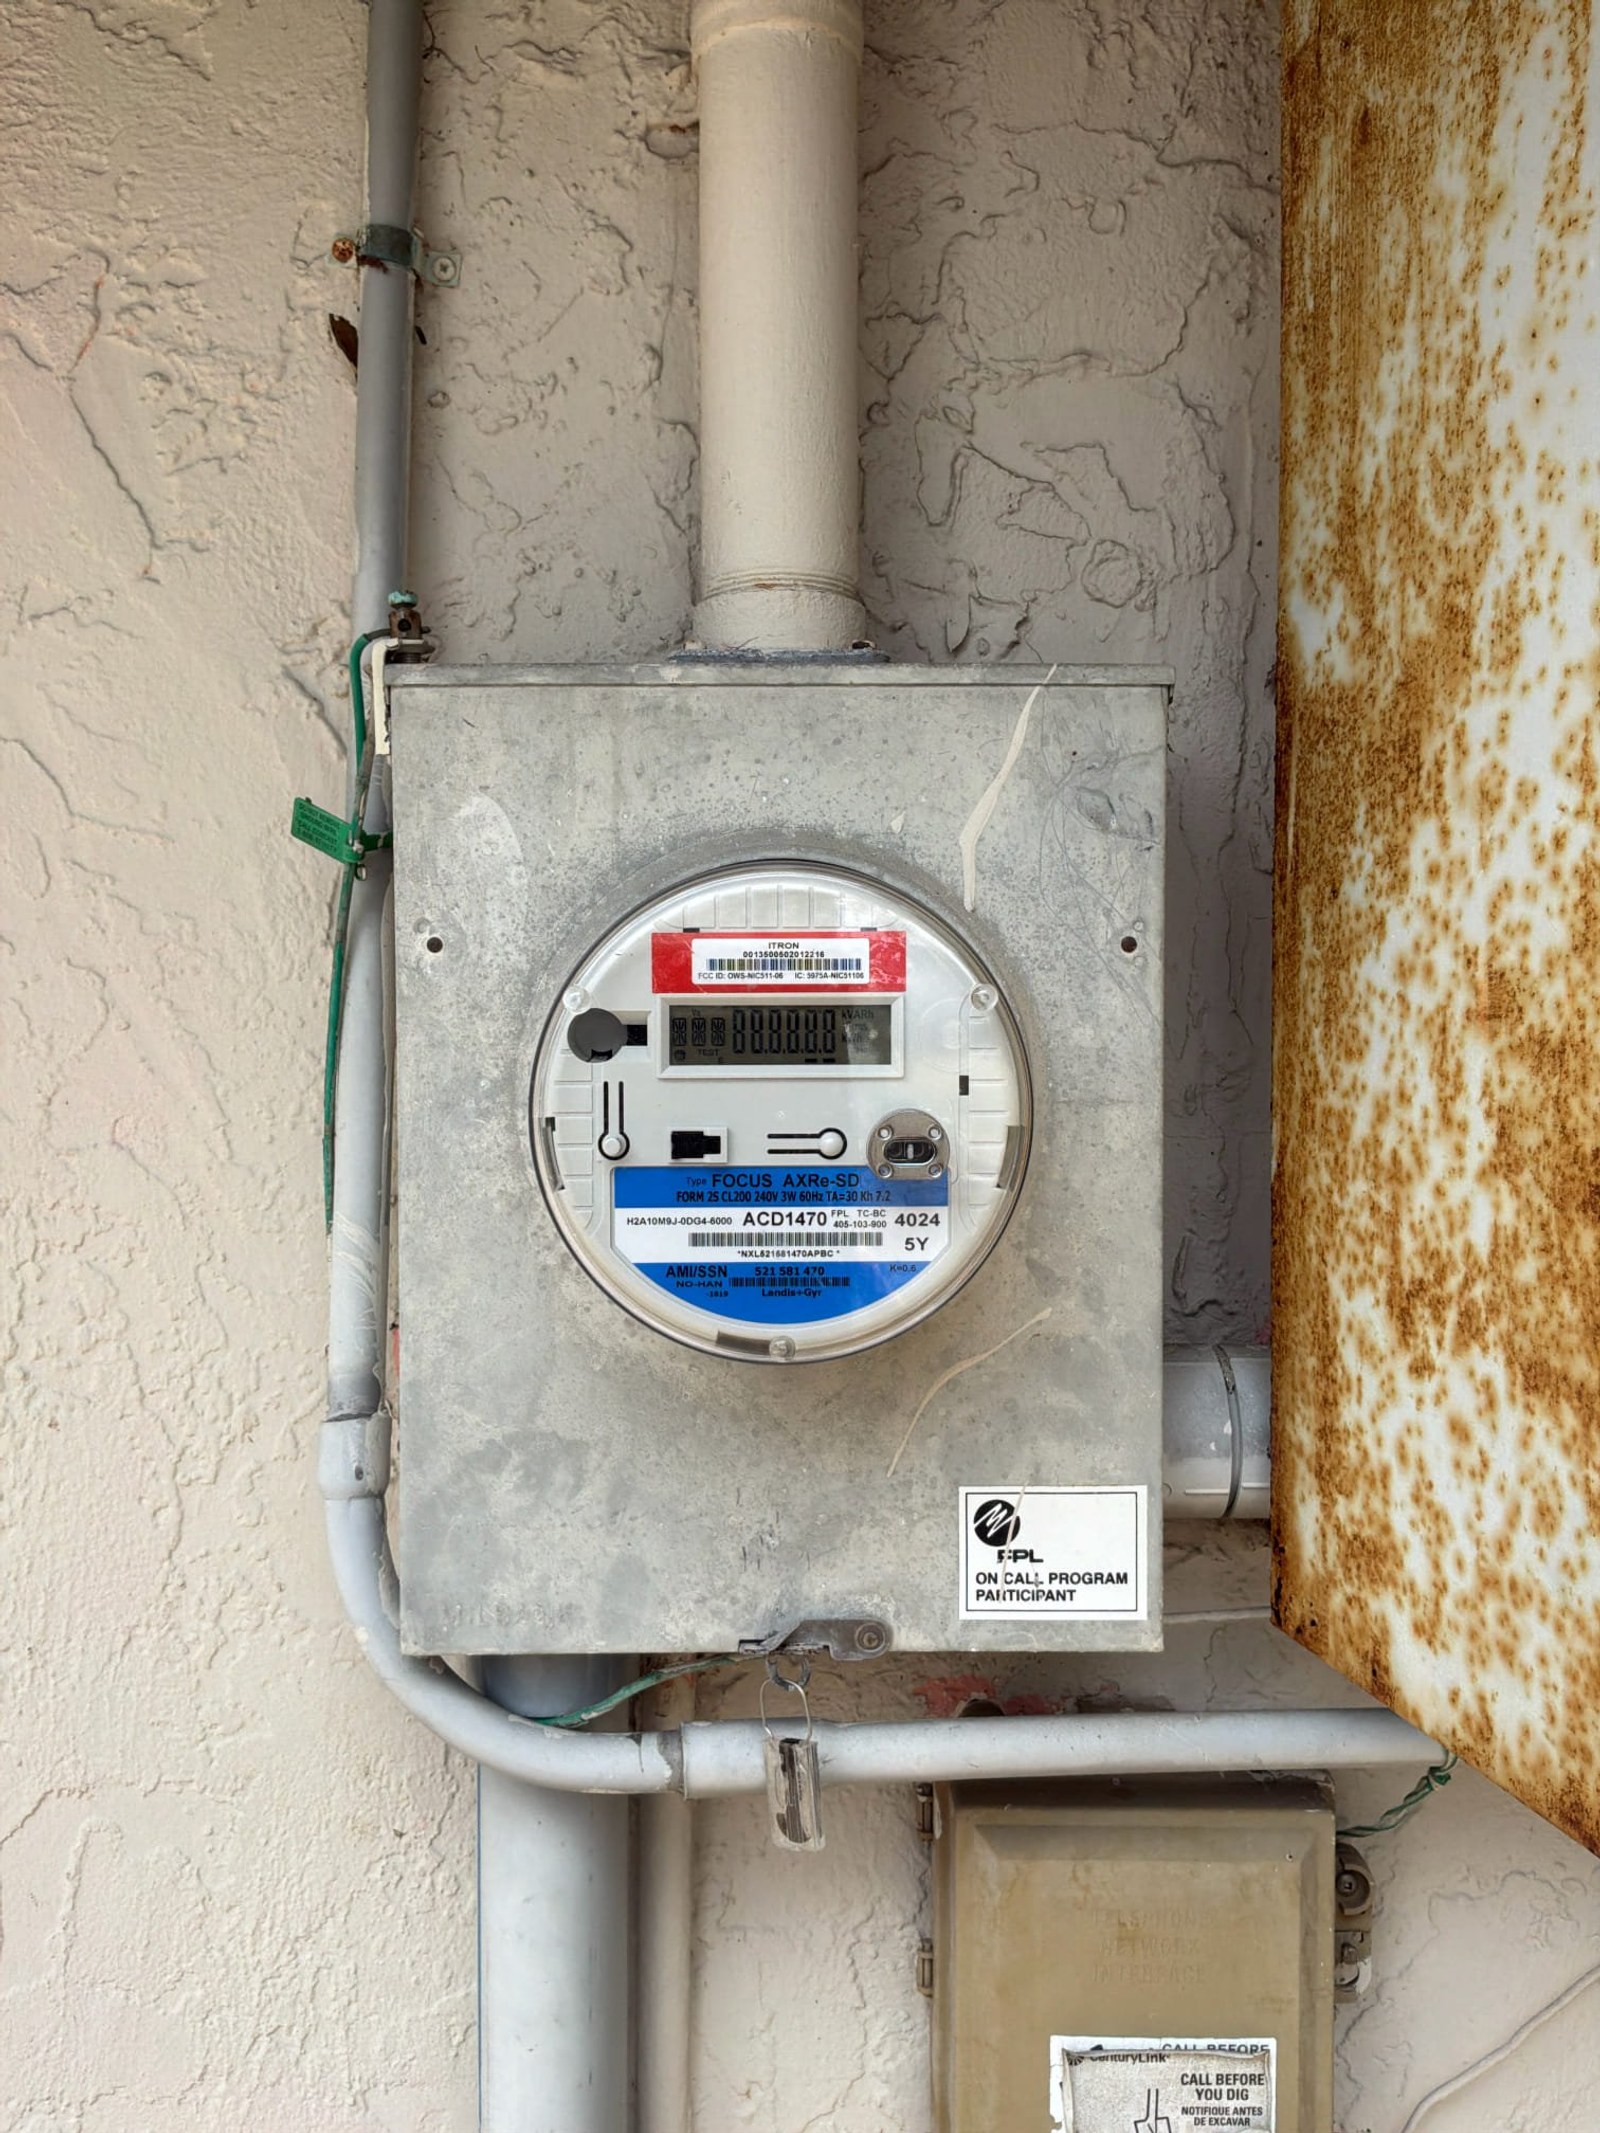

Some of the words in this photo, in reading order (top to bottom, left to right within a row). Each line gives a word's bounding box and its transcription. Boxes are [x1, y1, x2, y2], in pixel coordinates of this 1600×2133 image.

[768, 942, 800, 950] ITRON
[686, 1177, 707, 1187] Type
[712, 1173, 773, 1188] FOCUS
[783, 1173, 859, 1188] AXRe-SD
[677, 1191, 704, 1202] FORM
[721, 1191, 750, 1202] CL200
[754, 1191, 779, 1202] 240V
[781, 1191, 796, 1202] 3W
[799, 1191, 824, 1202] 60Hz
[826, 1191, 858, 1202] TA=30
[860, 1191, 873, 1202] Kh
[875, 1191, 891, 1202] 7.2
[742, 1211, 827, 1226] ACD1470
[894, 1212, 941, 1227] 4024
[904, 1237, 929, 1251] 5Y
[665, 1265, 728, 1278] AMI/SSN
[755, 1266, 775, 1276] 521
[779, 1266, 800, 1276] 581
[803, 1266, 825, 1276] 470
[761, 1288, 823, 1298] Landis+Gyr
[997, 1549, 1044, 1563] FPL
[975, 1572, 998, 1584] ON
[1004, 1572, 1044, 1584] CALL
[1049, 1572, 1128, 1584] PROGRAM
[976, 1589, 1077, 1602] PARTICIPANT
[1181, 2073, 1212, 2086] CALL
[1216, 2073, 1265, 2086] BEFORE
[1195, 2088, 1222, 2101] YOU
[1227, 2088, 1249, 2101] DIG
[1181, 2106, 1230, 2116] NOTIFIQUE
[1232, 2106, 1263, 2116] ANTES
[1194, 2117, 1206, 2127] DE
[1208, 2117, 1251, 2127] EXCAVAR
